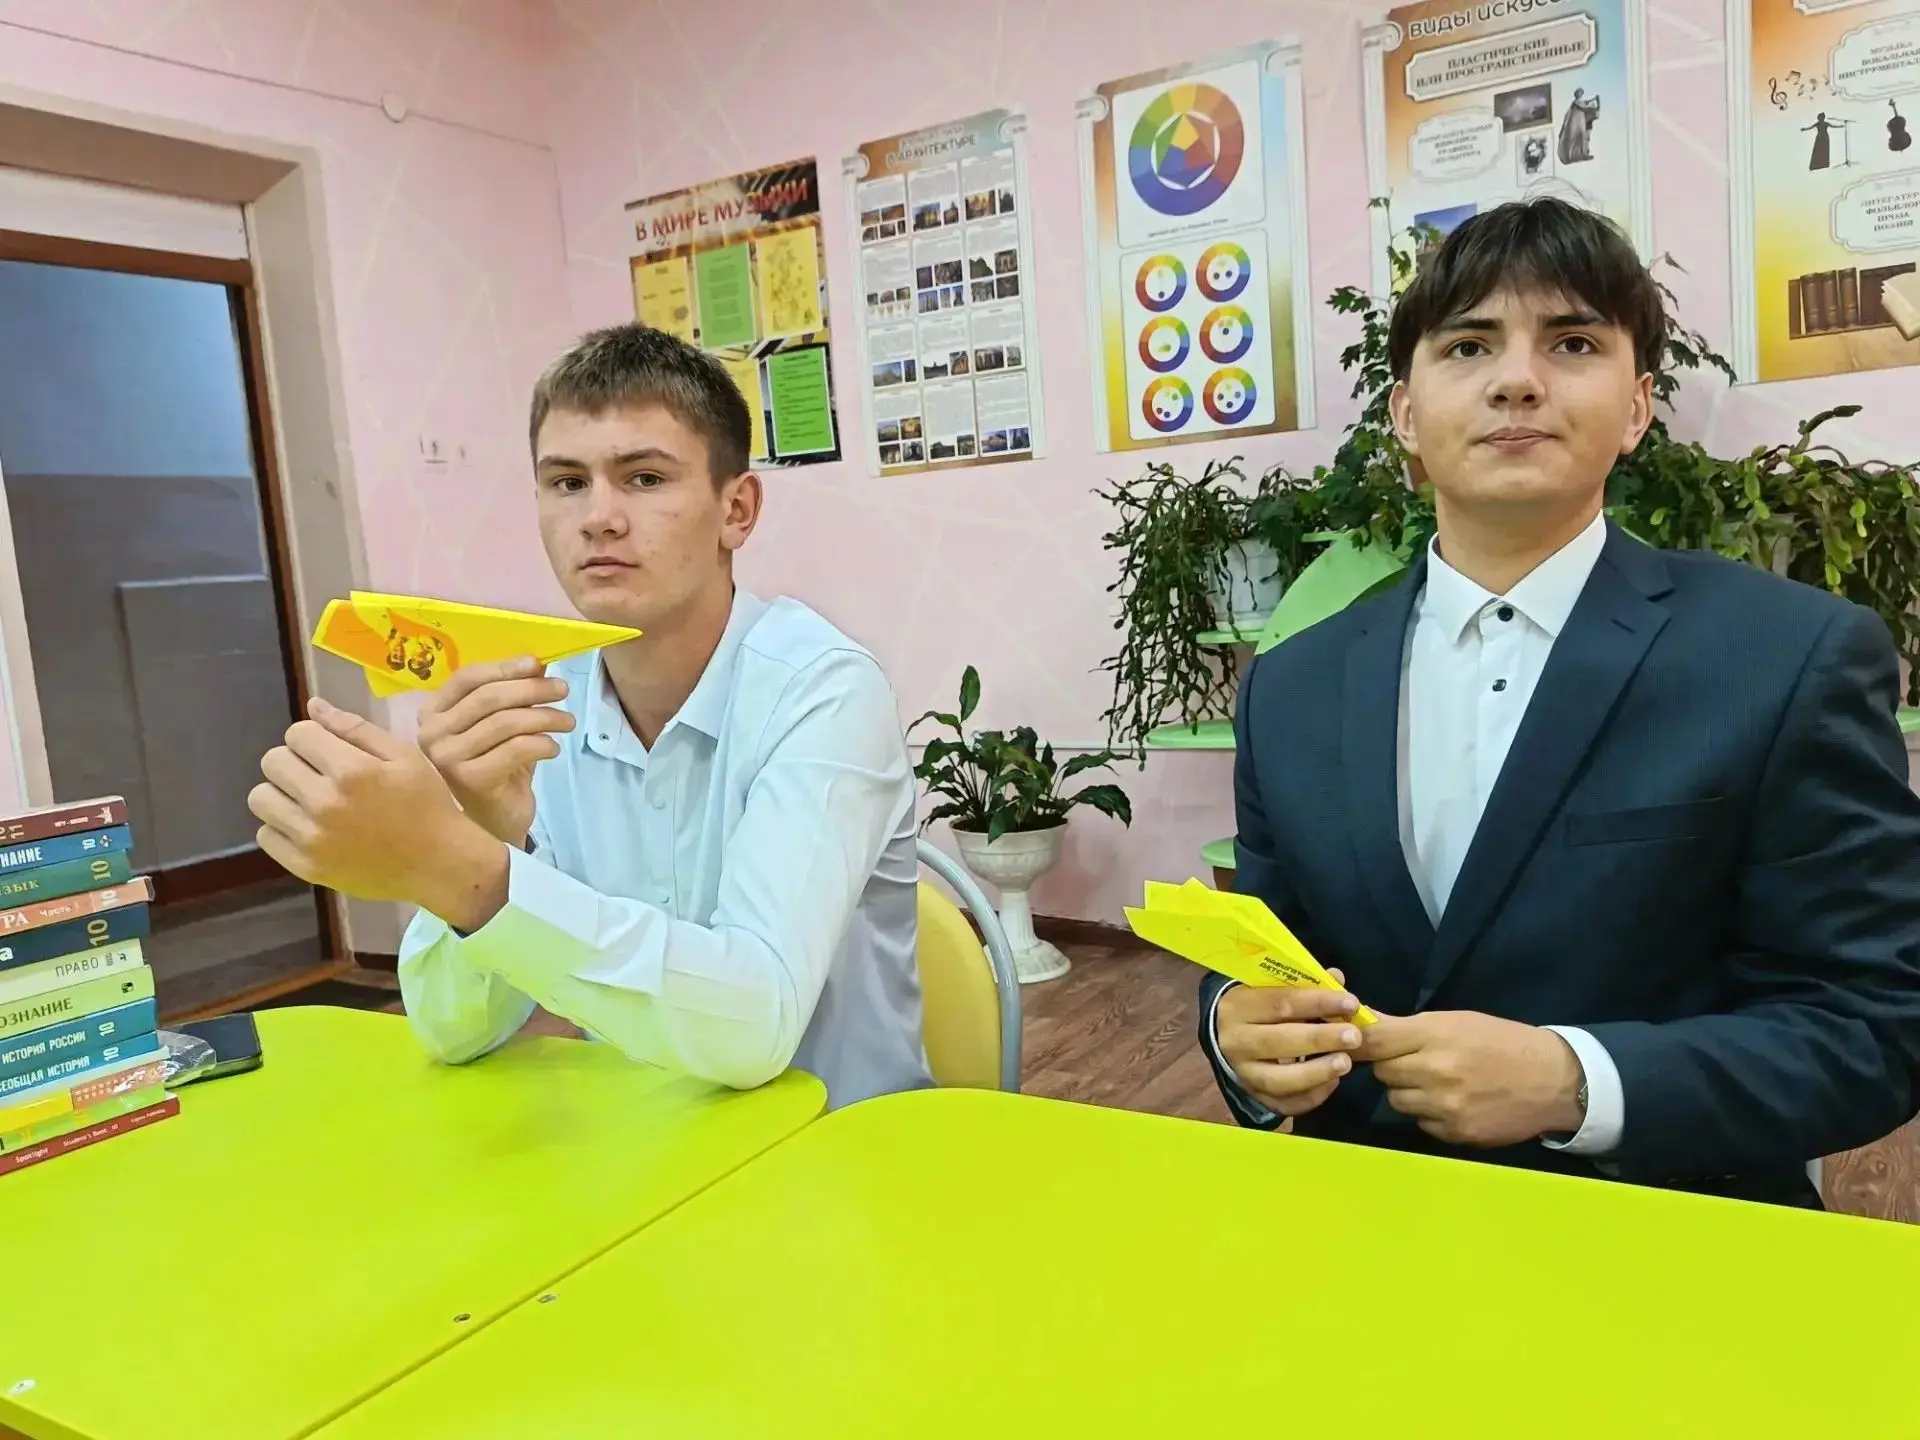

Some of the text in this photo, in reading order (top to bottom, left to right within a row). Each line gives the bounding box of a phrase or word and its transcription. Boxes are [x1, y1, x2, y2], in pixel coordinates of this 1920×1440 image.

[1416, 41, 1586, 88] ИЛИ ПРОСТРАНСТВЕННЫЕ
[1447, 37, 1550, 69] ПЛАСТИЧЕСКИЕ
[635, 177, 808, 241] В МИРЕ МУЗЫКИ
[90, 860, 111, 880] 10
[100, 889, 117, 906] 10
[86, 919, 111, 947] 10
[55, 957, 100, 978] ПРАВО
[2, 1021, 115, 1065] ИСТОРИЯ РОССИИ 10
[0, 1046, 119, 1093] ЕОБЩАЯ ИСТОРИЯ 10
[15, 1147, 49, 1164] Spotlight
